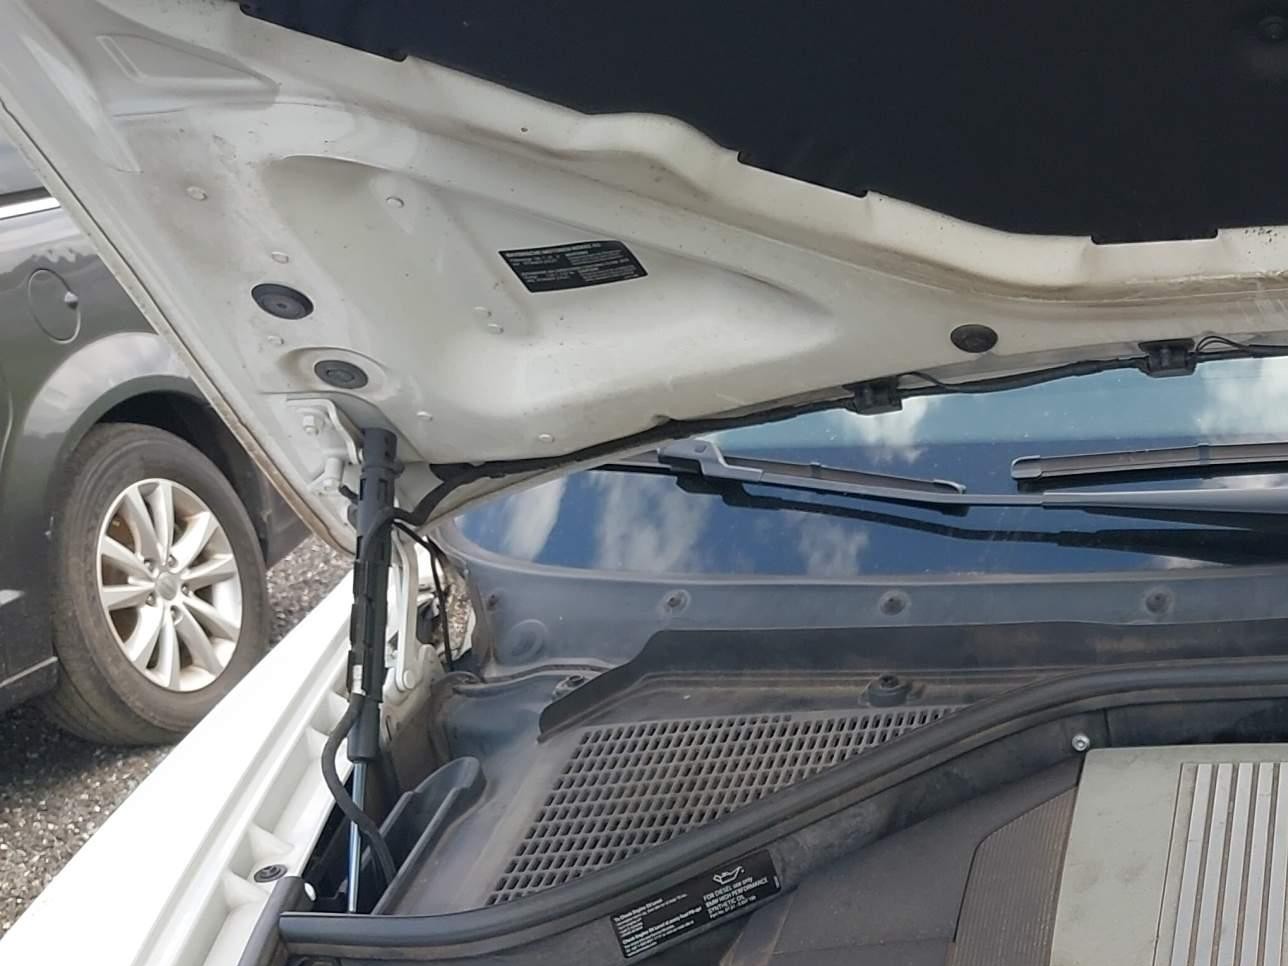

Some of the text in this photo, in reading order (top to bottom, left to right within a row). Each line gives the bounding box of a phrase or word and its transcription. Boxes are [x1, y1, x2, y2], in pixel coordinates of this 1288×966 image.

[703, 892, 715, 902] FOR
[714, 885, 733, 897] DIESEL
[705, 897, 719, 908] BMW
[718, 892, 732, 902] HIGH
[731, 876, 768, 896] PERFORMANCE
[707, 897, 737, 914] SYNTHETIC
